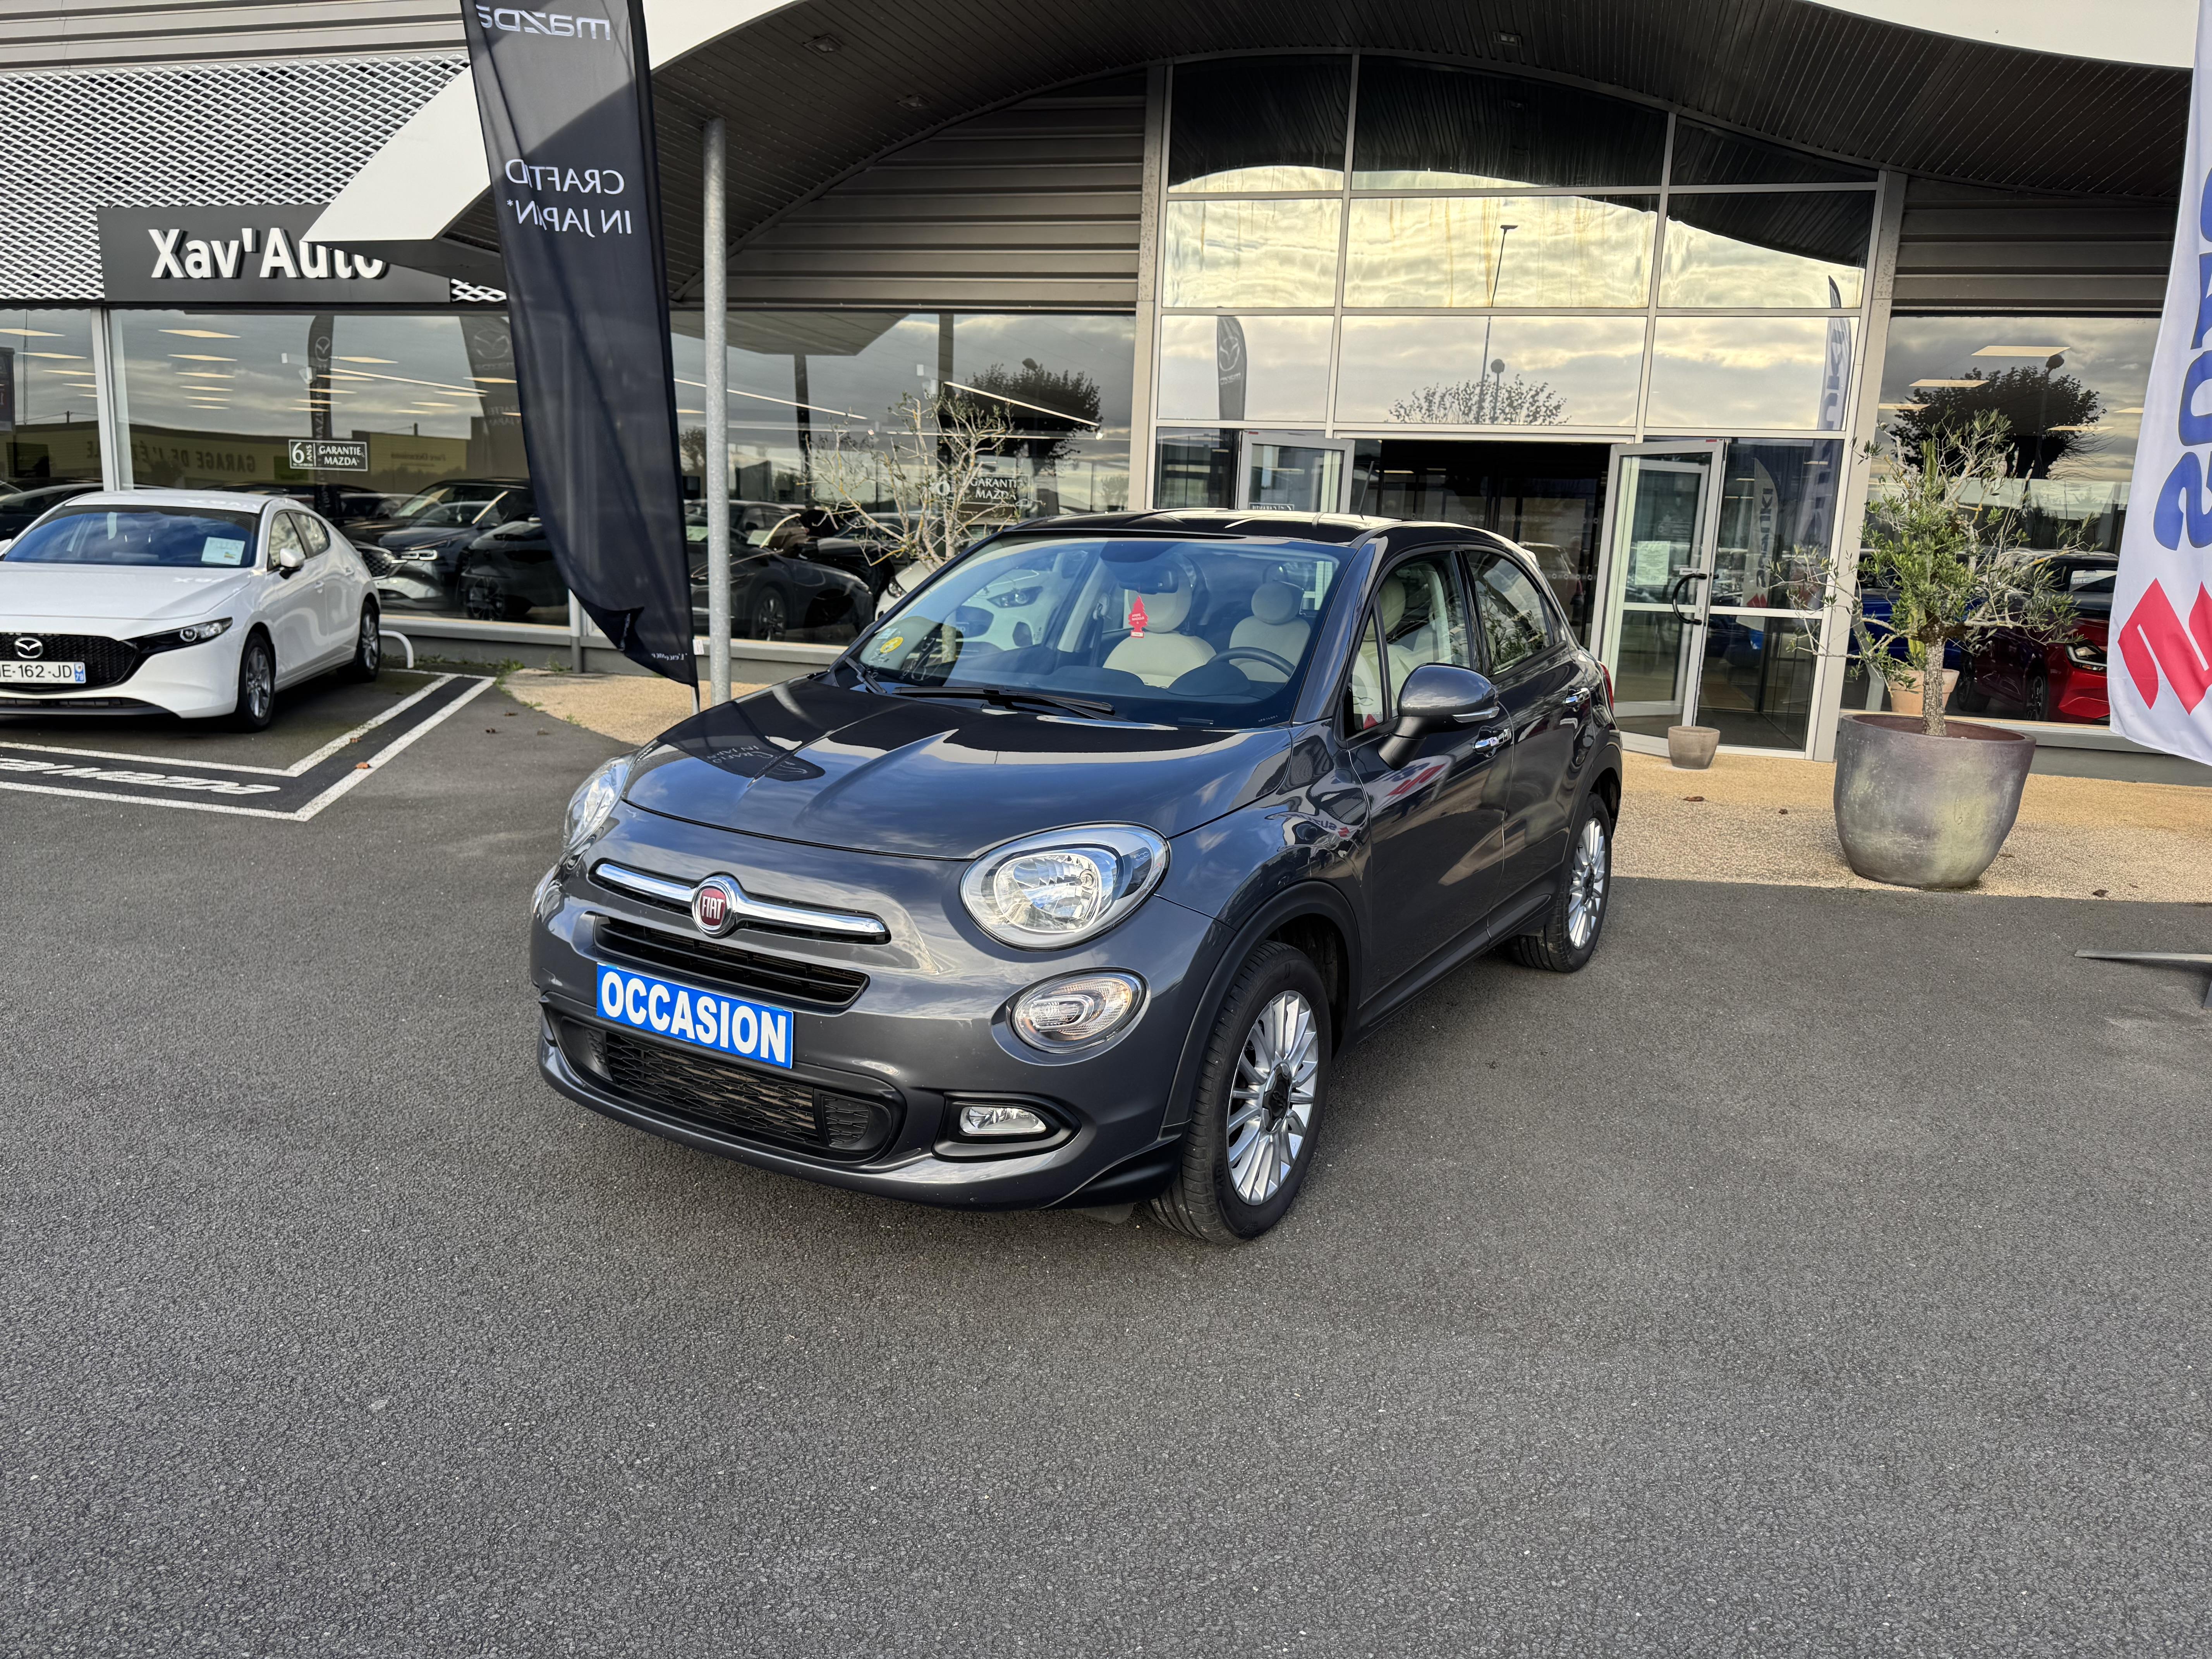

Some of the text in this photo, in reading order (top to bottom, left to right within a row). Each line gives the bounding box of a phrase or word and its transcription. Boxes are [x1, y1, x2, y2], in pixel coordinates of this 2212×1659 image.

[292, 442, 305, 464] 6
[318, 445, 362, 456] GARANTIE
[324, 456, 358, 466] MAZDA
[0, 665, 72, 678] E-162-JD
[701, 895, 724, 920] FIAT
[601, 971, 786, 1063] OCCASION
